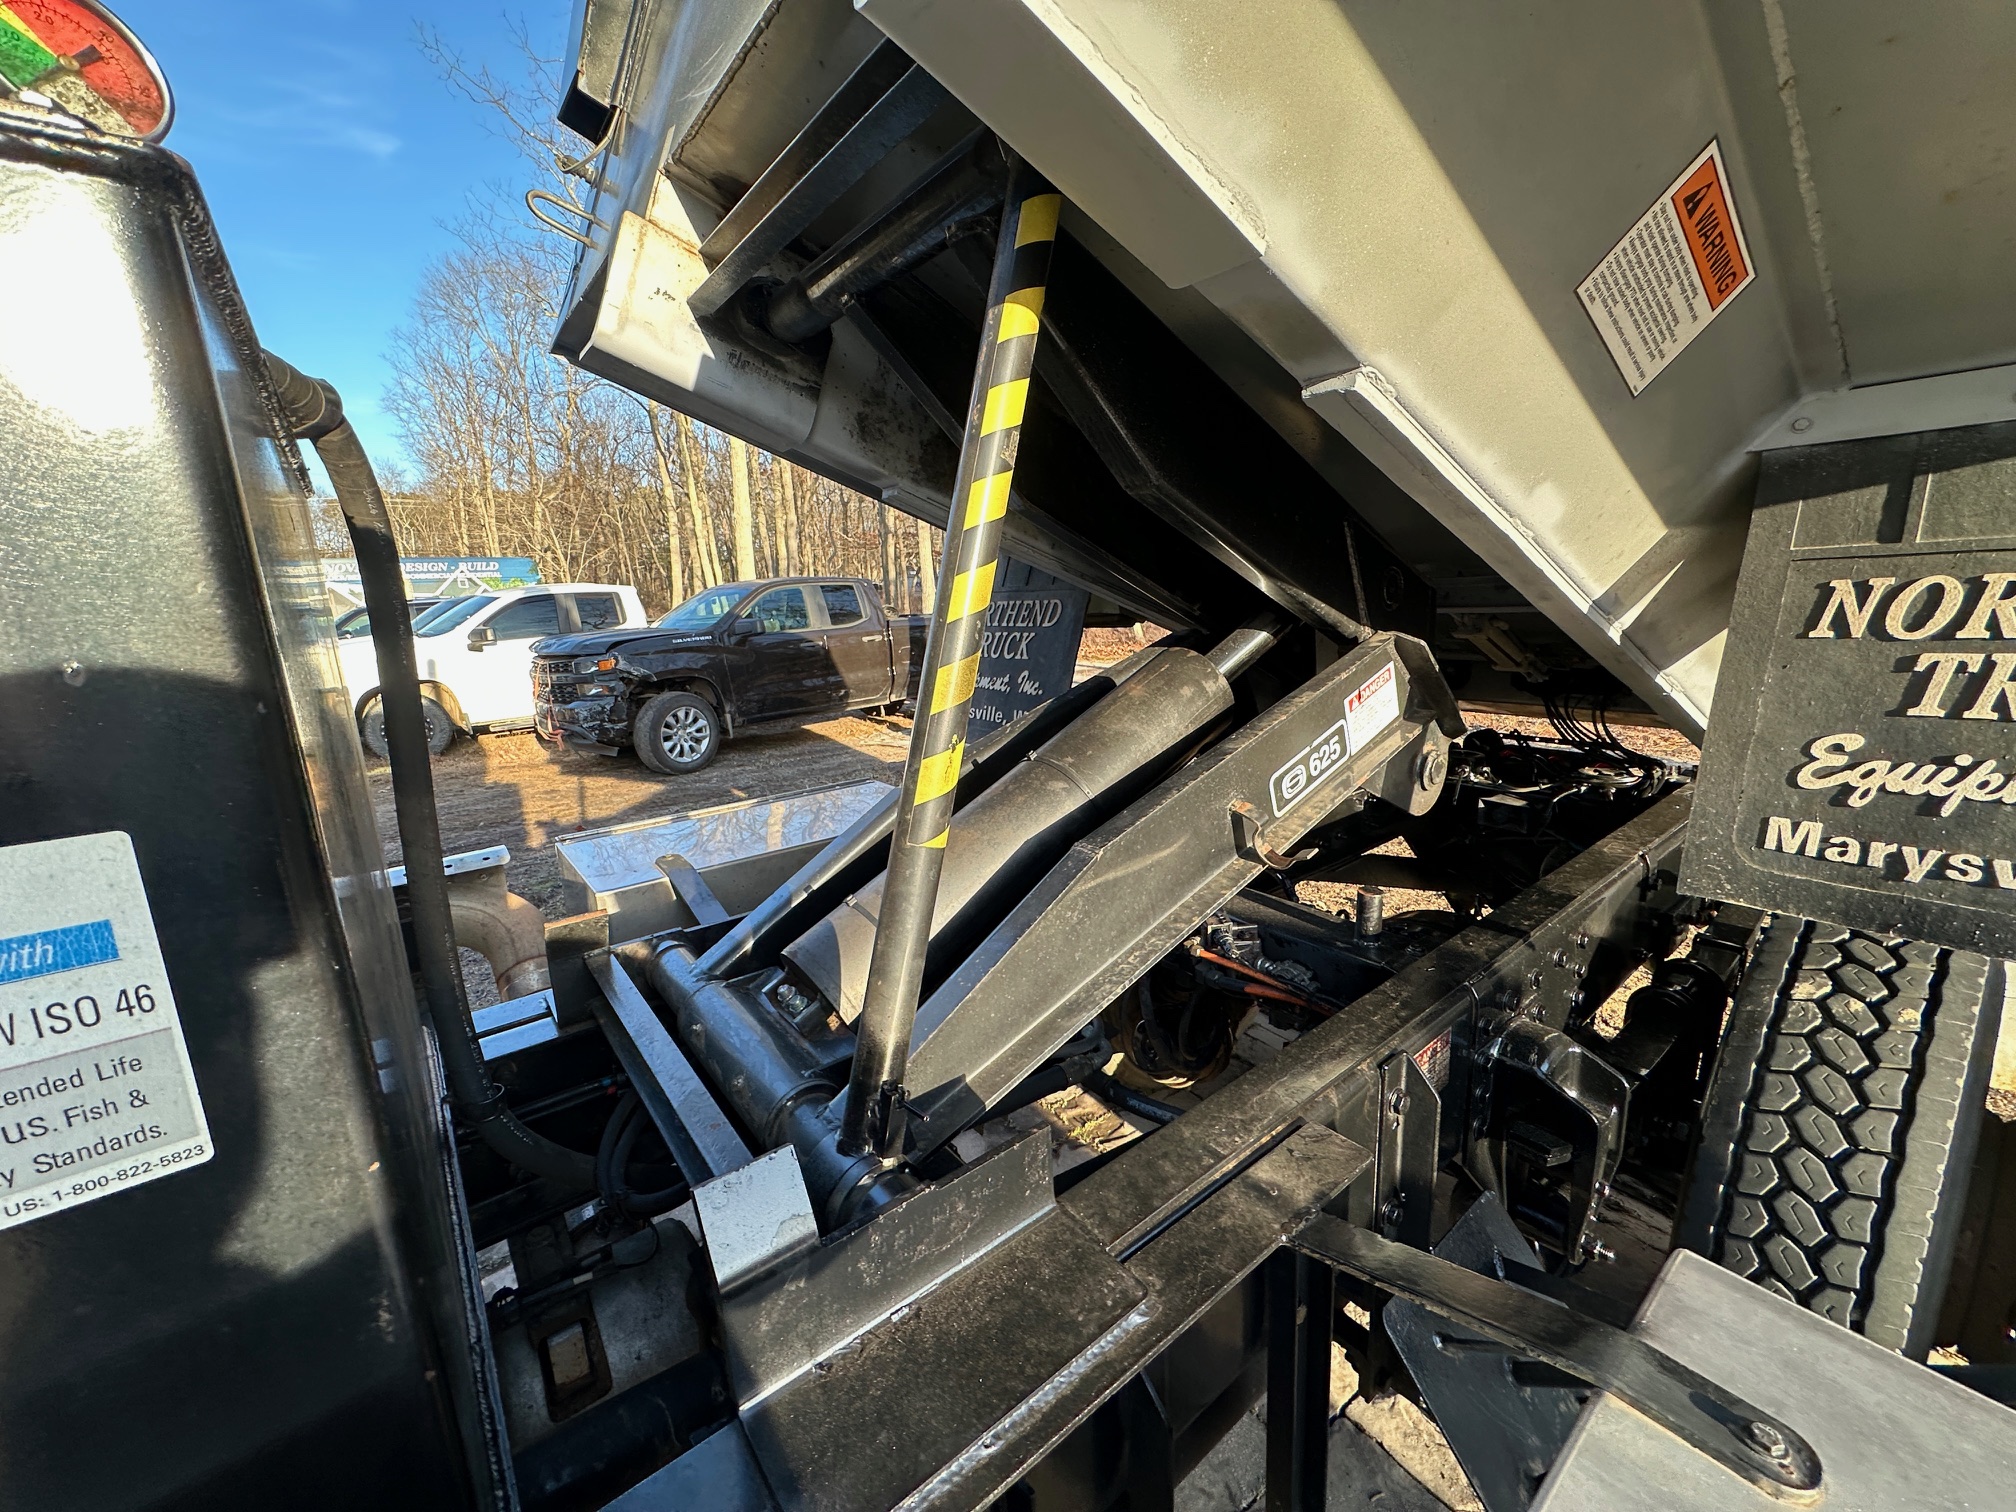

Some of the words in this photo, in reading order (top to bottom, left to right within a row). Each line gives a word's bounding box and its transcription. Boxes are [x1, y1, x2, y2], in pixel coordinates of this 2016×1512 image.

[34, 10, 54, 25] 20
[1694, 202, 1737, 297] WARNING
[458, 562, 499, 571] BUILD
[1017, 670, 1043, 696] Inc.
[1360, 671, 1390, 701] DANGER
[1309, 734, 1341, 777] 625
[1797, 733, 2016, 817] Equip
[30, 995, 102, 1039] ISO
[116, 984, 156, 1017] 46
[0, 1068, 85, 1109] ended
[94, 1056, 143, 1082] Life
[63, 1098, 119, 1128] Fish
[129, 1089, 151, 1109] &
[33, 1124, 168, 1175] Standards.
[3, 1197, 46, 1217] US:
[52, 1144, 206, 1202] 1-800-822-5823
